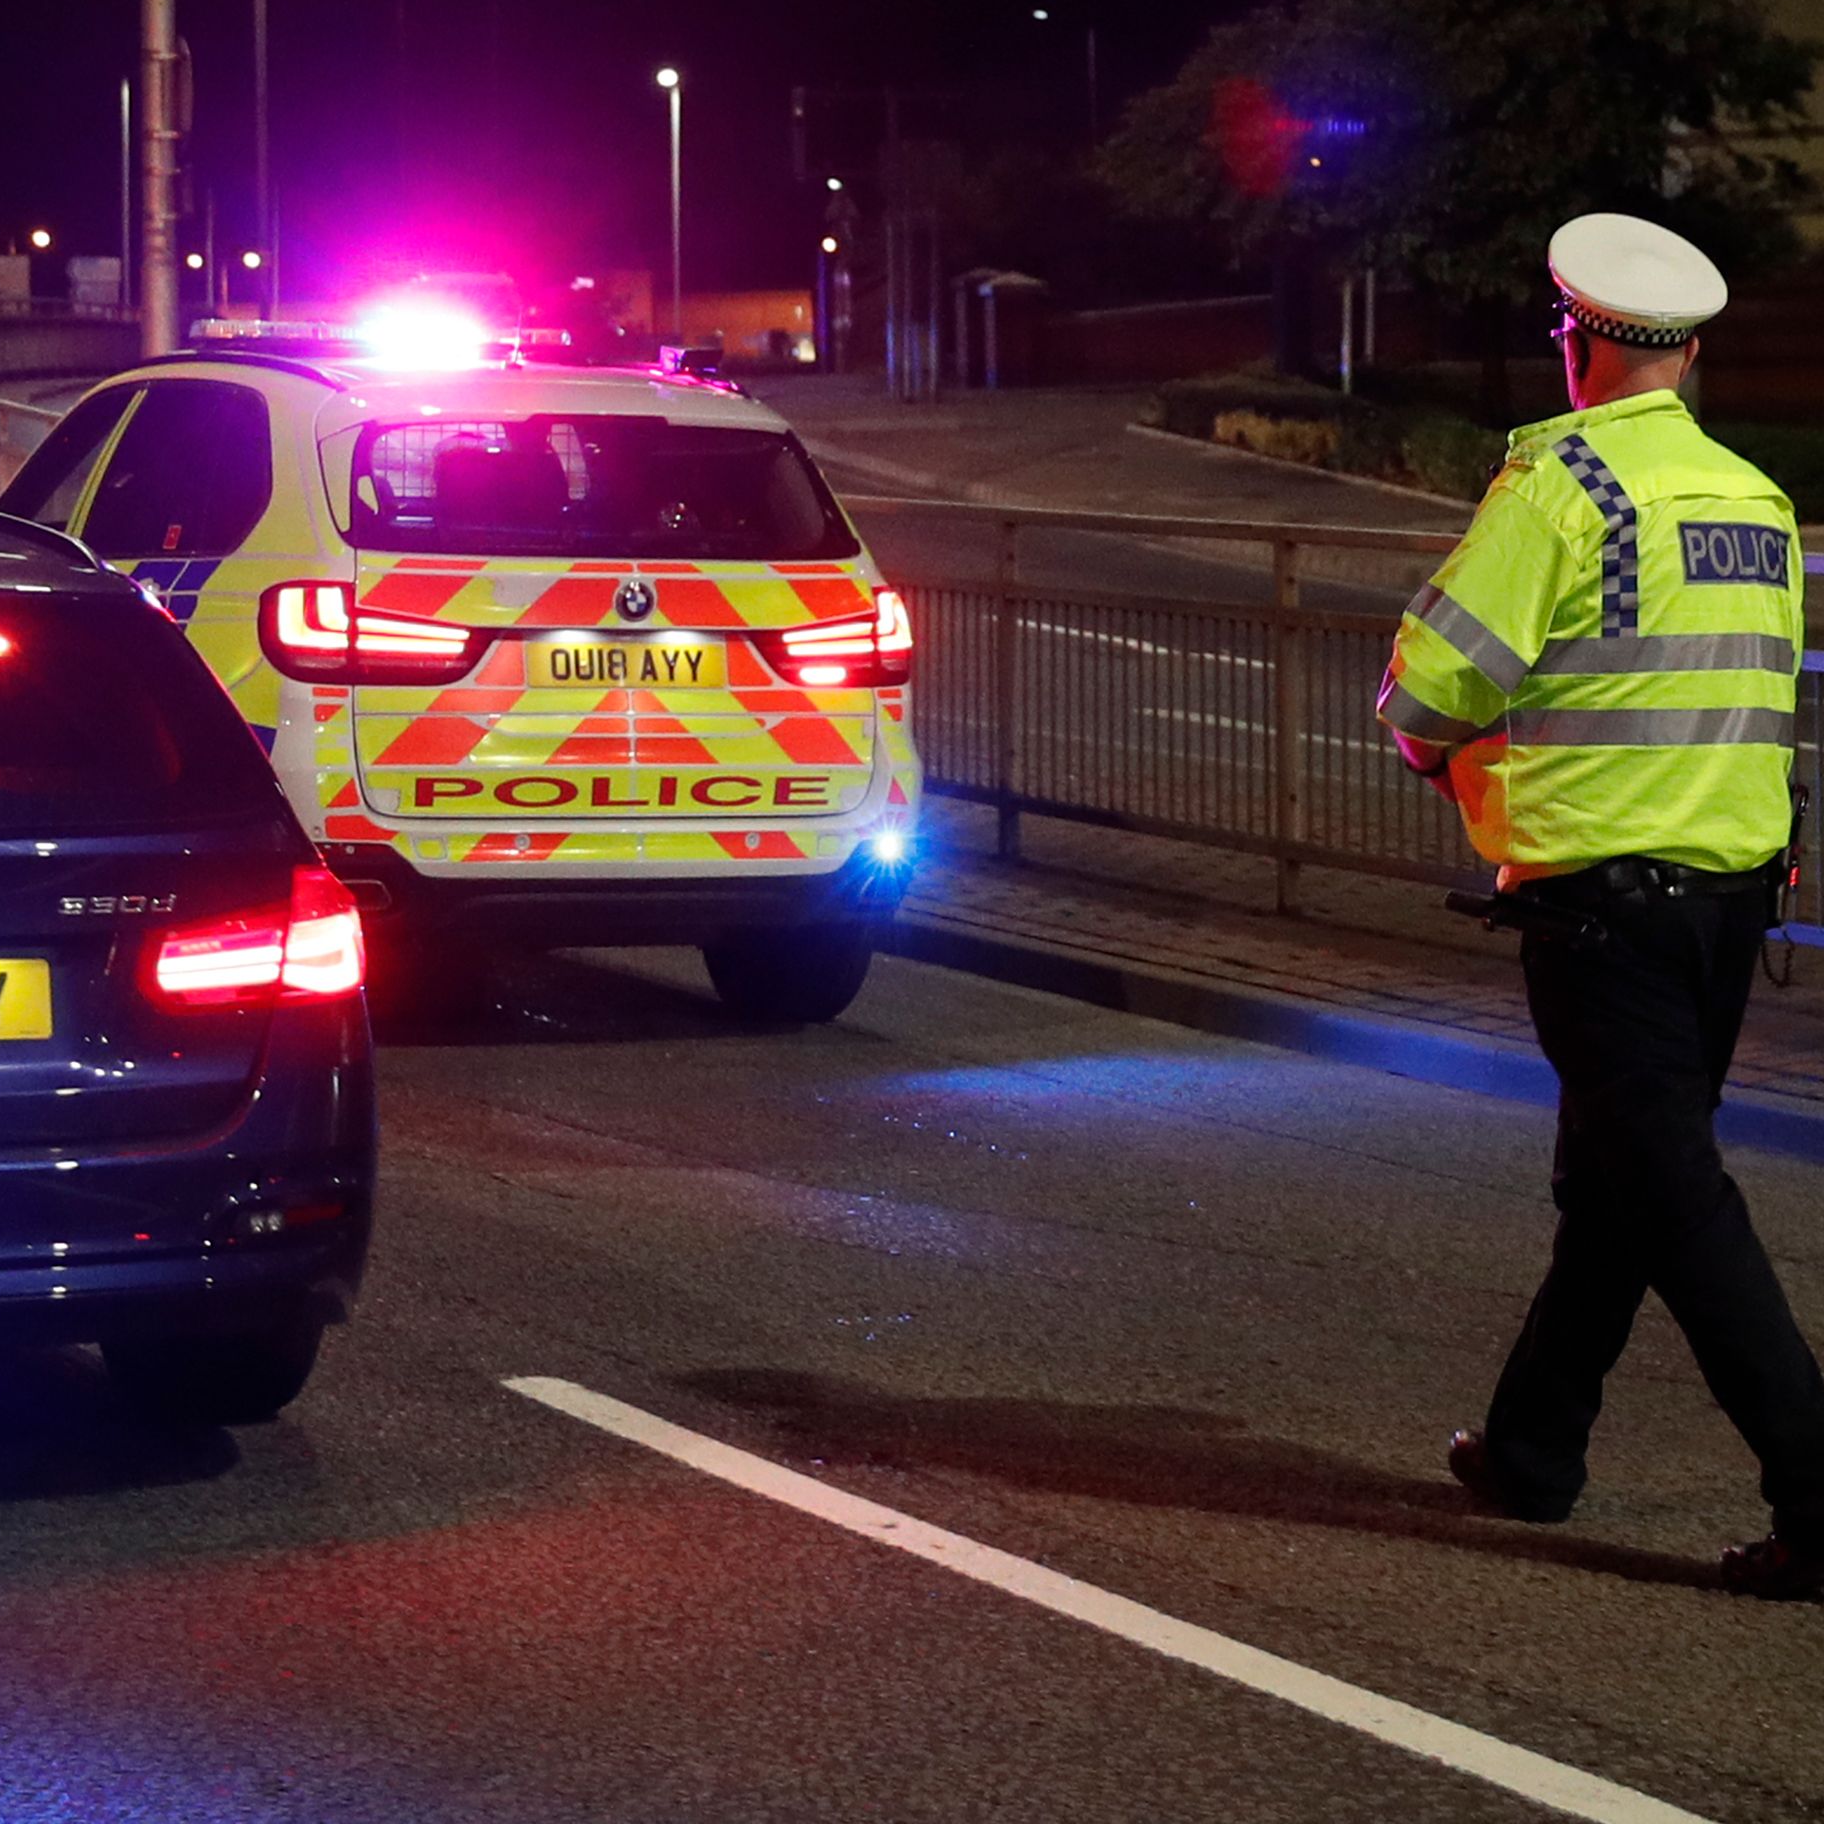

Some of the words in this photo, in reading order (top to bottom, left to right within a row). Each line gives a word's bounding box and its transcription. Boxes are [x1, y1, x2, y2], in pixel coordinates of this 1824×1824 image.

[551, 649, 626, 681] OU18
[641, 649, 702, 682] AYY
[414, 776, 829, 807] POLICE
